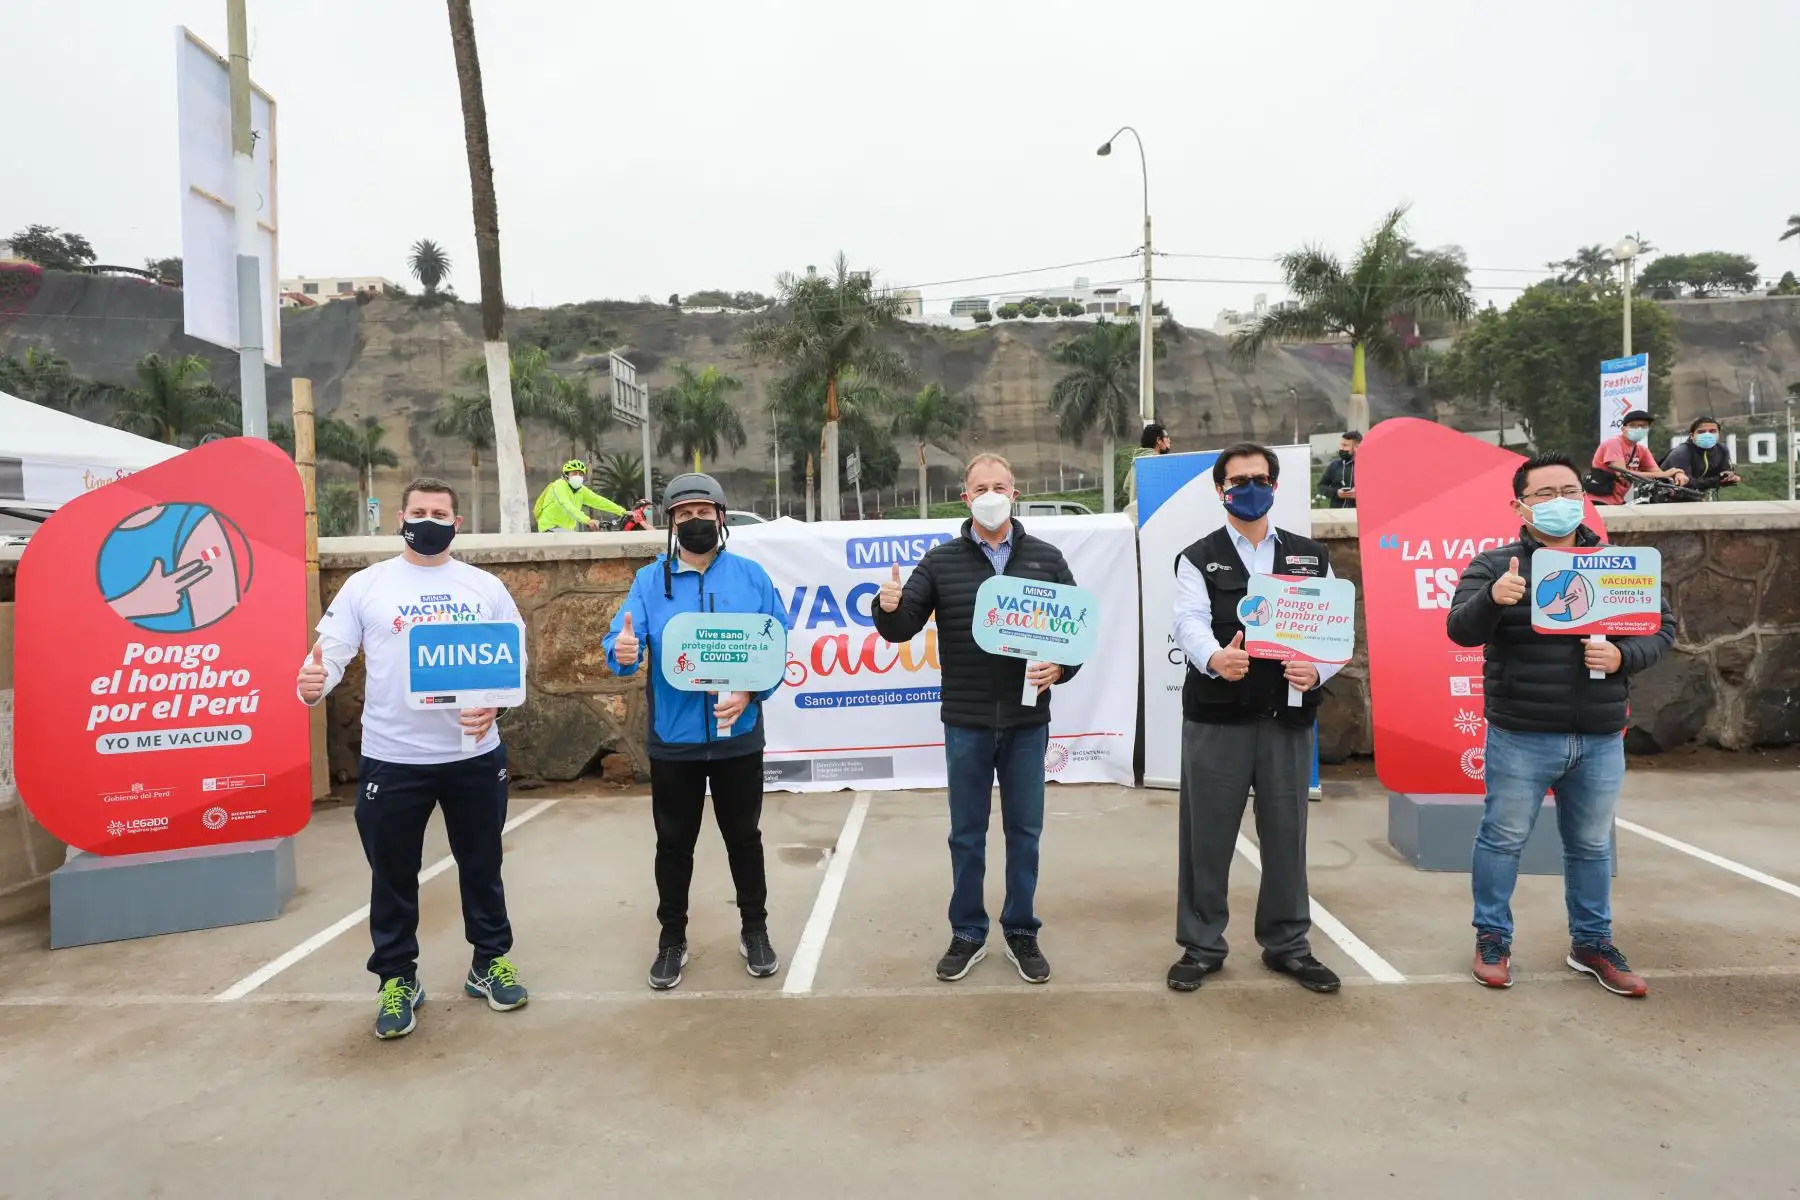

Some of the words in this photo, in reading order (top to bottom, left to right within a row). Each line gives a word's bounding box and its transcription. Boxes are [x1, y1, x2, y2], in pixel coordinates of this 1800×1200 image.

[1603, 373, 1643, 389] Festival
[1577, 556, 1632, 569] MINSA
[1025, 587, 1054, 598] MINSA
[1602, 595, 1652, 604] COVID-19
[398, 602, 471, 616] VACUNA
[996, 594, 1072, 620] VACUNA
[1276, 597, 1314, 611] Pongo
[1318, 601, 1330, 611] el
[1006, 608, 1080, 635] activa
[1275, 609, 1324, 622] hombro
[1326, 615, 1350, 625] por
[1275, 620, 1287, 630] el
[1289, 621, 1319, 632] Perú
[698, 630, 718, 639] Vive
[720, 631, 743, 639] sano
[744, 632, 750, 640] y
[681, 642, 726, 652] protegido
[728, 642, 757, 651] contra
[760, 642, 768, 651] la
[122, 642, 221, 669] Pongo
[417, 643, 513, 667] MINSA
[703, 652, 747, 661] COVID-19
[90, 669, 123, 695] el
[127, 665, 251, 693] hombro
[804, 696, 833, 706] Sano
[836, 696, 843, 707] y
[845, 691, 902, 707] protegido
[86, 700, 147, 731] por
[152, 693, 183, 719] el
[188, 689, 261, 717] Perú
[105, 737, 130, 750] YO
[137, 735, 162, 747] ME
[168, 729, 243, 745] VACUNO
[104, 793, 138, 803] Gobierno
[140, 791, 152, 800] del
